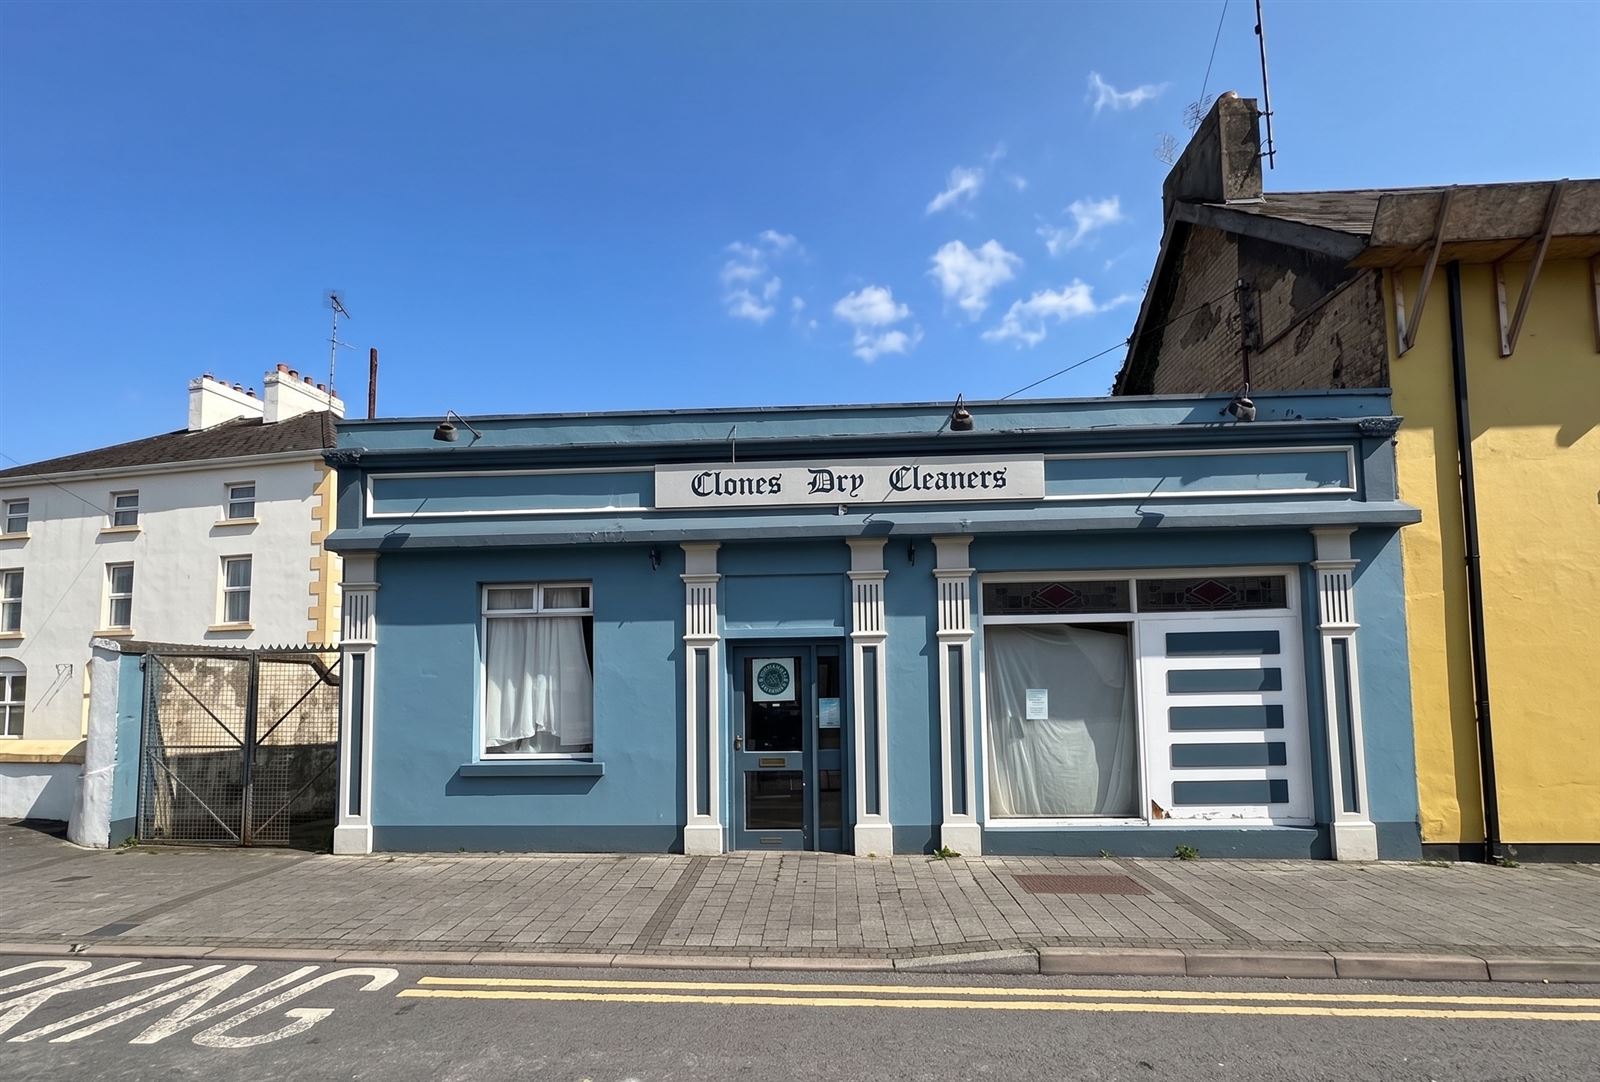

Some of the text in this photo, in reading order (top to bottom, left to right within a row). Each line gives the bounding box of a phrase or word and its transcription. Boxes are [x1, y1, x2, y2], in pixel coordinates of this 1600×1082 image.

[691, 465, 1008, 498] Clones Dry Cleaners
